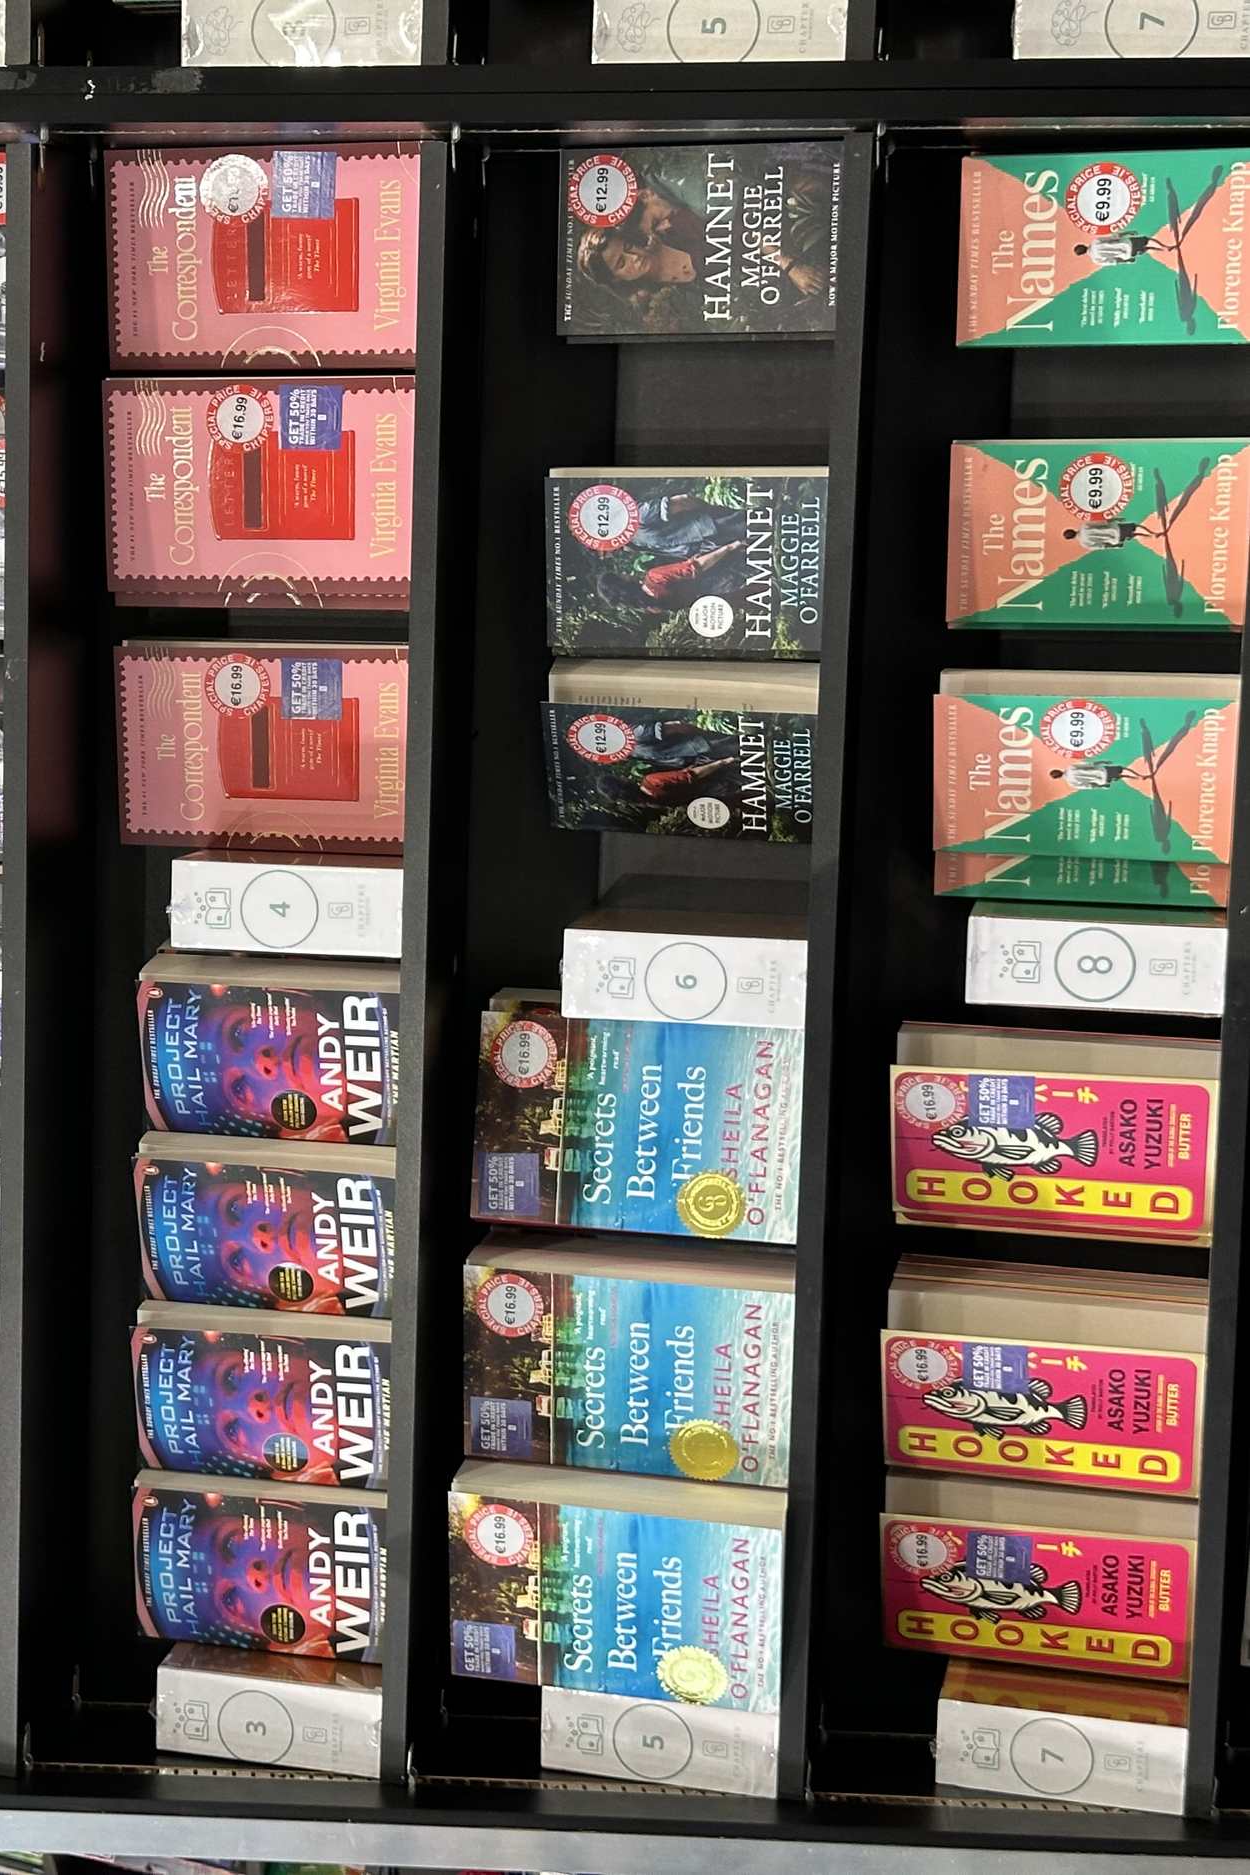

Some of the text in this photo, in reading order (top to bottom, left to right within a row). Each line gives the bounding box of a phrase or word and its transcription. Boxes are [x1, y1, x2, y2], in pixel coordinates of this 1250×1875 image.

[701, 18, 725, 34] 5
[1138, 11, 1164, 31] 7
[595, 167, 609, 213] €12.99
[832, 162, 840, 201] PICTURE
[1095, 178, 1111, 222] €9.99
[703, 153, 734, 321] HAMNET
[741, 185, 762, 287] MAGGIE
[760, 166, 783, 305] O'FARRELL
[830, 204, 839, 241] MOTION
[992, 230, 1015, 274] The
[1006, 170, 1059, 331] Names
[1217, 162, 1250, 329] Florence Knapp
[829, 245, 837, 273] MAJOR
[828, 286, 836, 306] NOW
[232, 397, 247, 440] €16.99
[289, 389, 300, 445] GET 50%
[144, 473, 166, 502] The
[165, 406, 199, 565] Correspondent
[370, 413, 403, 559] Virginia Evans
[597, 497, 609, 537] €12.99
[1088, 468, 1103, 509] €9.99
[745, 482, 773, 638] HAMNET
[780, 513, 799, 607] MAGGIE
[800, 497, 820, 624] O'FARRELL
[982, 514, 1004, 555] The
[996, 458, 1048, 611] Names
[1204, 454, 1238, 614] Florence Knapp
[230, 665, 243, 706] €16.99
[156, 734, 176, 760] The
[180, 671, 208, 821] Correspondent
[374, 682, 404, 819] Virginia Evans
[594, 723, 606, 753] €12.99
[1070, 712, 1084, 747] €9.99
[738, 714, 767, 832] HAMNET
[773, 739, 793, 810] MAGGIE
[793, 728, 812, 823] O'FARRELL
[968, 754, 991, 790] The
[984, 707, 1034, 842] Names
[1192, 708, 1225, 851] Florence Knapp
[269, 902, 290, 917] 4
[675, 974, 697, 989] 6
[1077, 955, 1113, 974] 8
[166, 998, 190, 1114] PROJECT
[184, 989, 211, 1125] HAIL MARY
[317, 1013, 343, 1111] ANDY
[343, 995, 382, 1135] WEIR
[518, 1033, 530, 1075] €16.99
[626, 1064, 662, 1200] Between
[671, 1066, 707, 1183] Friends
[747, 1040, 774, 1225] O'FLANAGAN
[923, 1084, 937, 1120] €16.99
[1119, 1099, 1137, 1168] ASAKO
[1144, 1099, 1164, 1170] YUZUKI
[1178, 1113, 1192, 1159] BUTTER
[582, 1093, 617, 1204] Secrets
[916, 1176, 1180, 1214] HOOKED
[311, 1192, 340, 1284] ANDY
[337, 1177, 379, 1308] WEIR
[504, 1286, 517, 1325] €16.99
[576, 1346, 606, 1449] Secrets
[620, 1322, 650, 1447] Between
[664, 1325, 695, 1430] Friends
[741, 1304, 762, 1472] O'FLANAGAN
[916, 1349, 928, 1381] €16.99
[1108, 1369, 1126, 1432] ASAKO
[308, 1359, 334, 1456] ANDY
[335, 1344, 374, 1479] WEIR
[1134, 1369, 1152, 1434] YUZUKI
[908, 1432, 1168, 1476] HOOKED
[493, 1516, 506, 1554] €16.99
[916, 1534, 929, 1566] €16.99
[308, 1527, 332, 1627] ANDY
[334, 1511, 371, 1653] WEIR
[608, 1553, 637, 1671] Between
[652, 1556, 682, 1657] Friends
[1101, 1555, 1120, 1616] ASAKO
[1125, 1555, 1145, 1619] YUZUKI
[564, 1574, 593, 1672] Secrets
[730, 1538, 750, 1700] O'FLANAGAN
[906, 1615, 1160, 1661] HOOKED
[246, 1721, 266, 1736] 3
[642, 1735, 664, 1750] 5
[1041, 1748, 1064, 1763] 7
